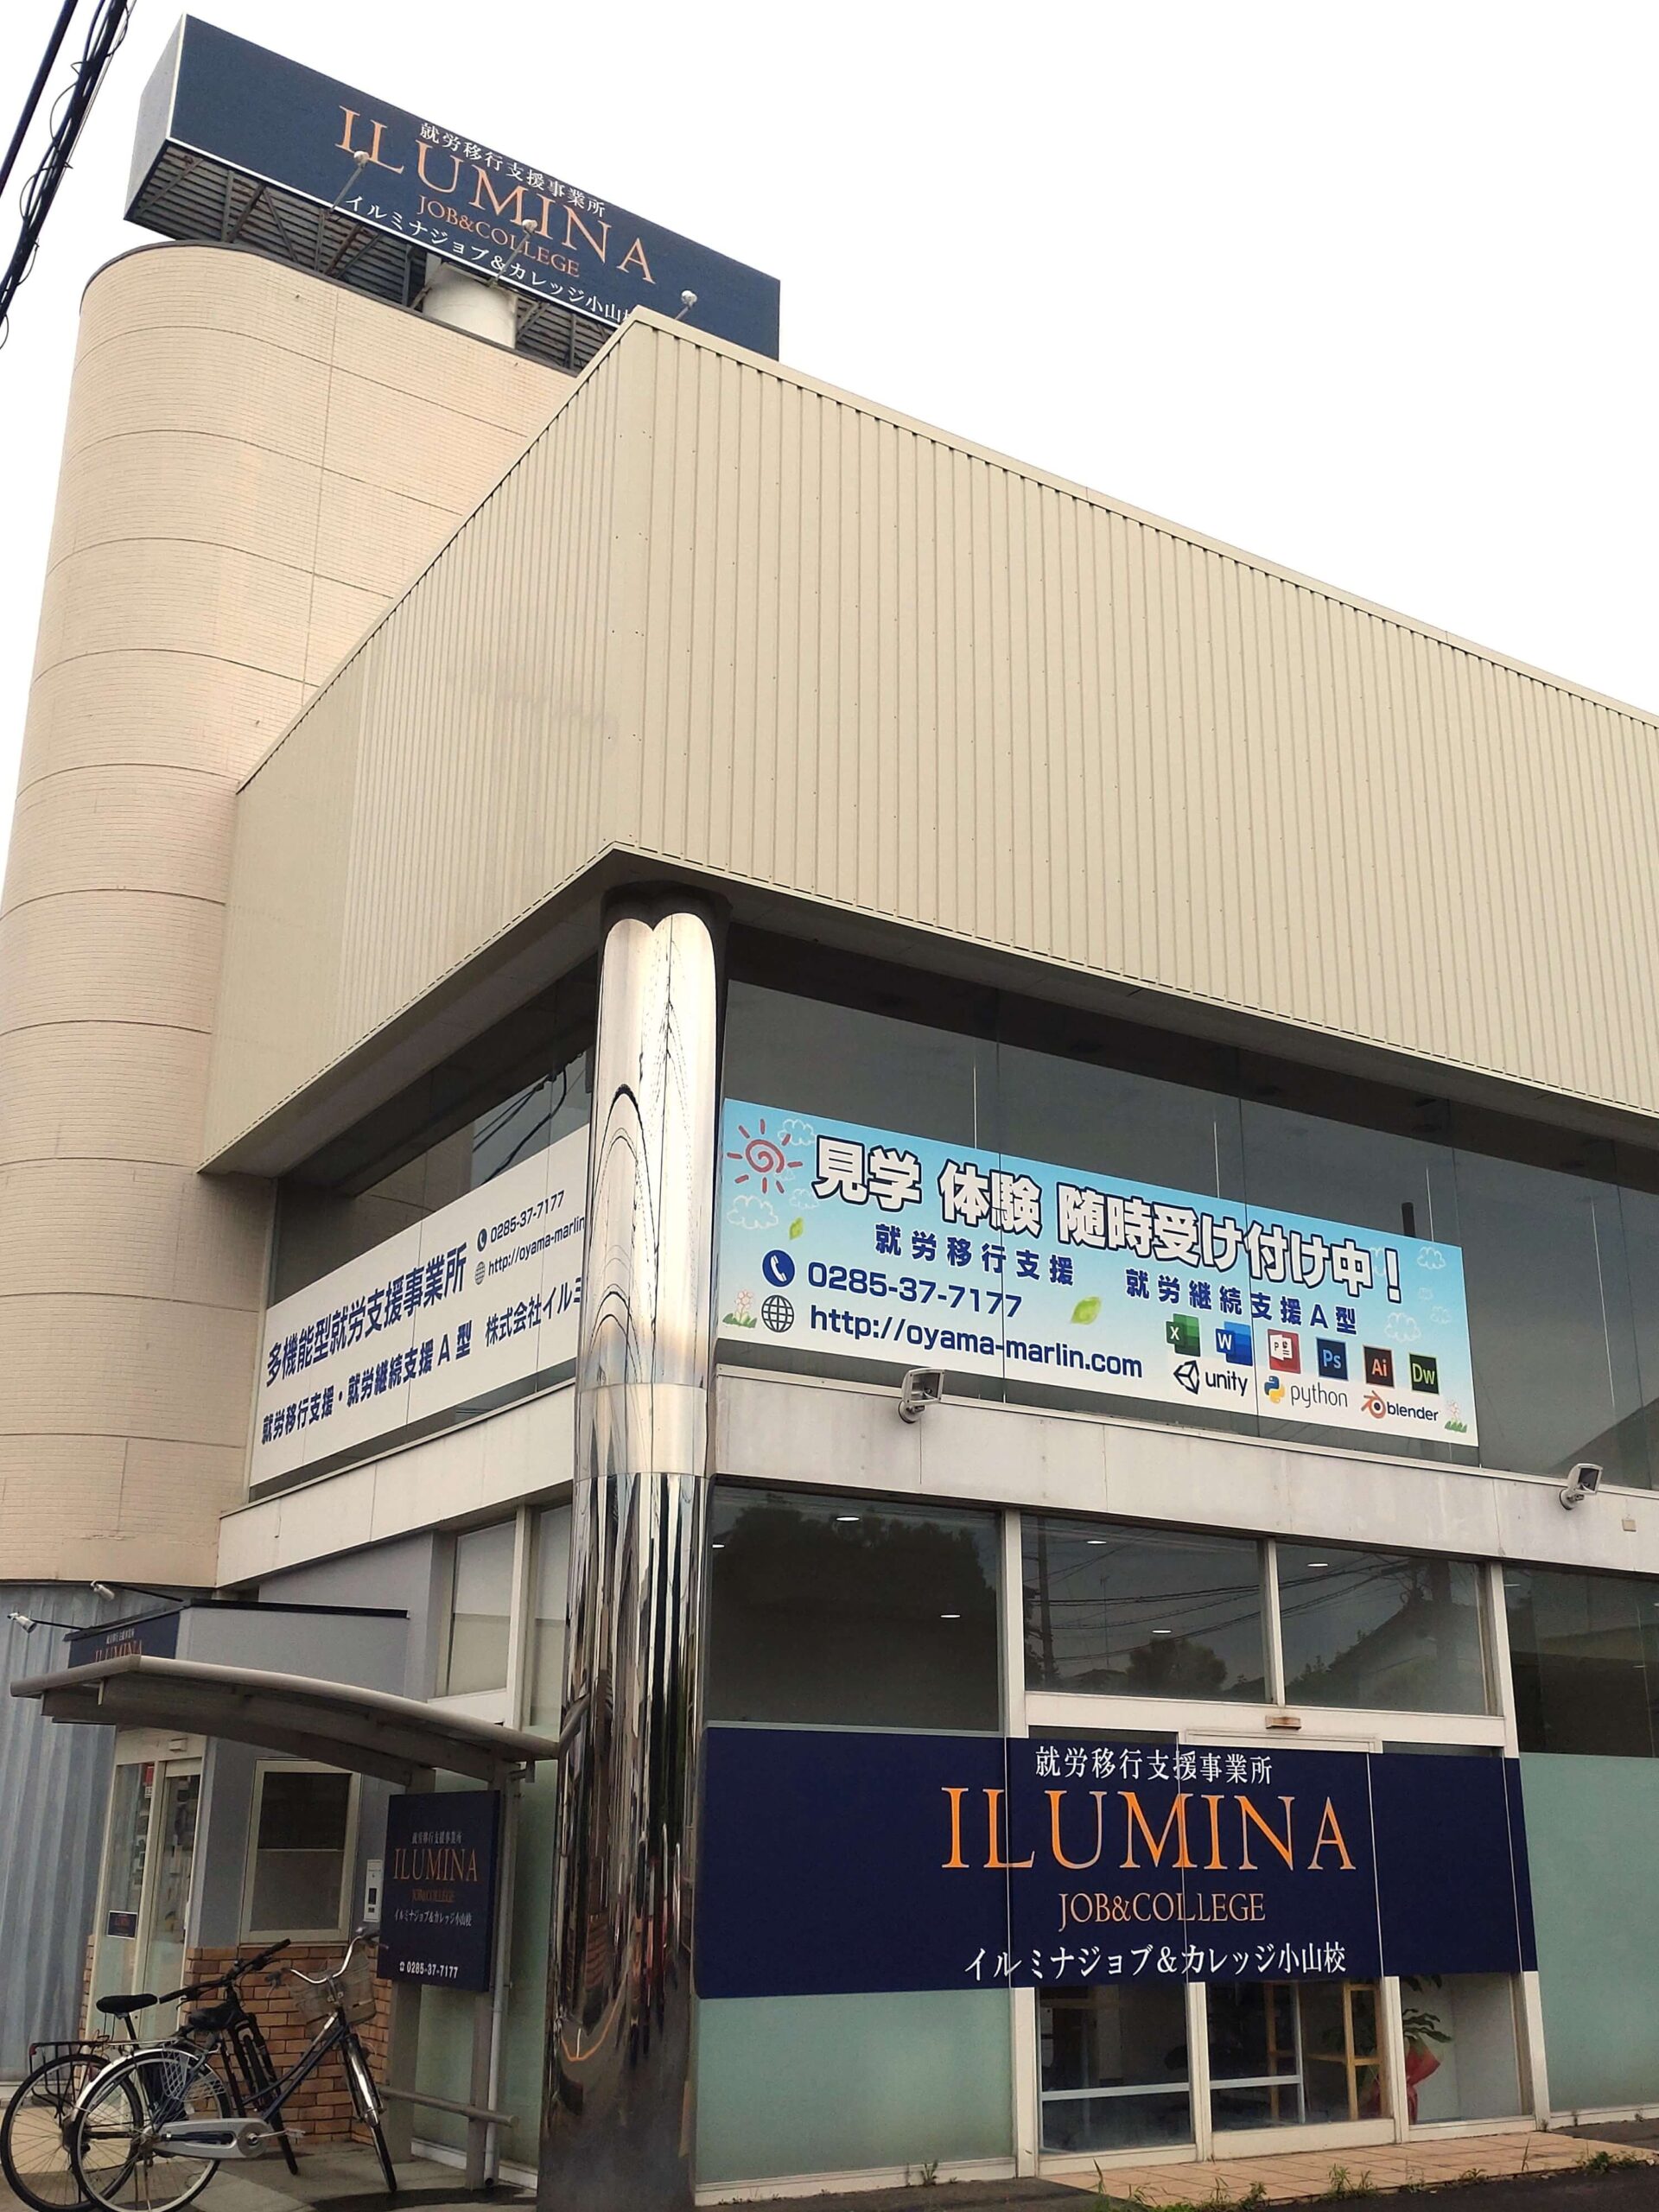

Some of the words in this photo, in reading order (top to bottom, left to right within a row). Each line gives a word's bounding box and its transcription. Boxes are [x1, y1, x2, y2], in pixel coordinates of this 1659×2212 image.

[420, 123, 605, 217] 就労移行支援事業所
[334, 105, 656, 284] ILUMINA
[417, 195, 580, 277] JOB&COLLEGE
[811, 1135, 922, 1211] 見学
[938, 1159, 1043, 1237] 体験
[490, 1190, 565, 1243] 0285-37-7177
[808, 1262, 1022, 1318] 0285-37-7177
[875, 1224, 1074, 1286] 就労移行支援
[1125, 1268, 1357, 1335] 就労継続支援A型
[266, 1242, 467, 1387] 多機能型就労支援事業所
[1168, 1325, 1180, 1341] X
[810, 1305, 1142, 1378] http://oyama-marlin.com
[1217, 1332, 1233, 1351] W
[1322, 1350, 1342, 1369] Ps
[1205, 1370, 1248, 1396] unity
[1371, 1358, 1388, 1377] Ai
[1412, 1362, 1435, 1385] Dw
[1290, 1382, 1348, 1408] python
[1387, 1402, 1439, 1422] blender
[1035, 1745, 1273, 1785] 就労移行支援事業所
[941, 1786, 1357, 1871] ILUMINA
[393, 1848, 478, 1882] ILUMINA
[1058, 1892, 1266, 1932] JOB&COLLEGE
[406, 1961, 459, 1979] 0285-37-7177
[964, 1941, 1347, 1981] イルミナジョブ&カレッジ小山校
